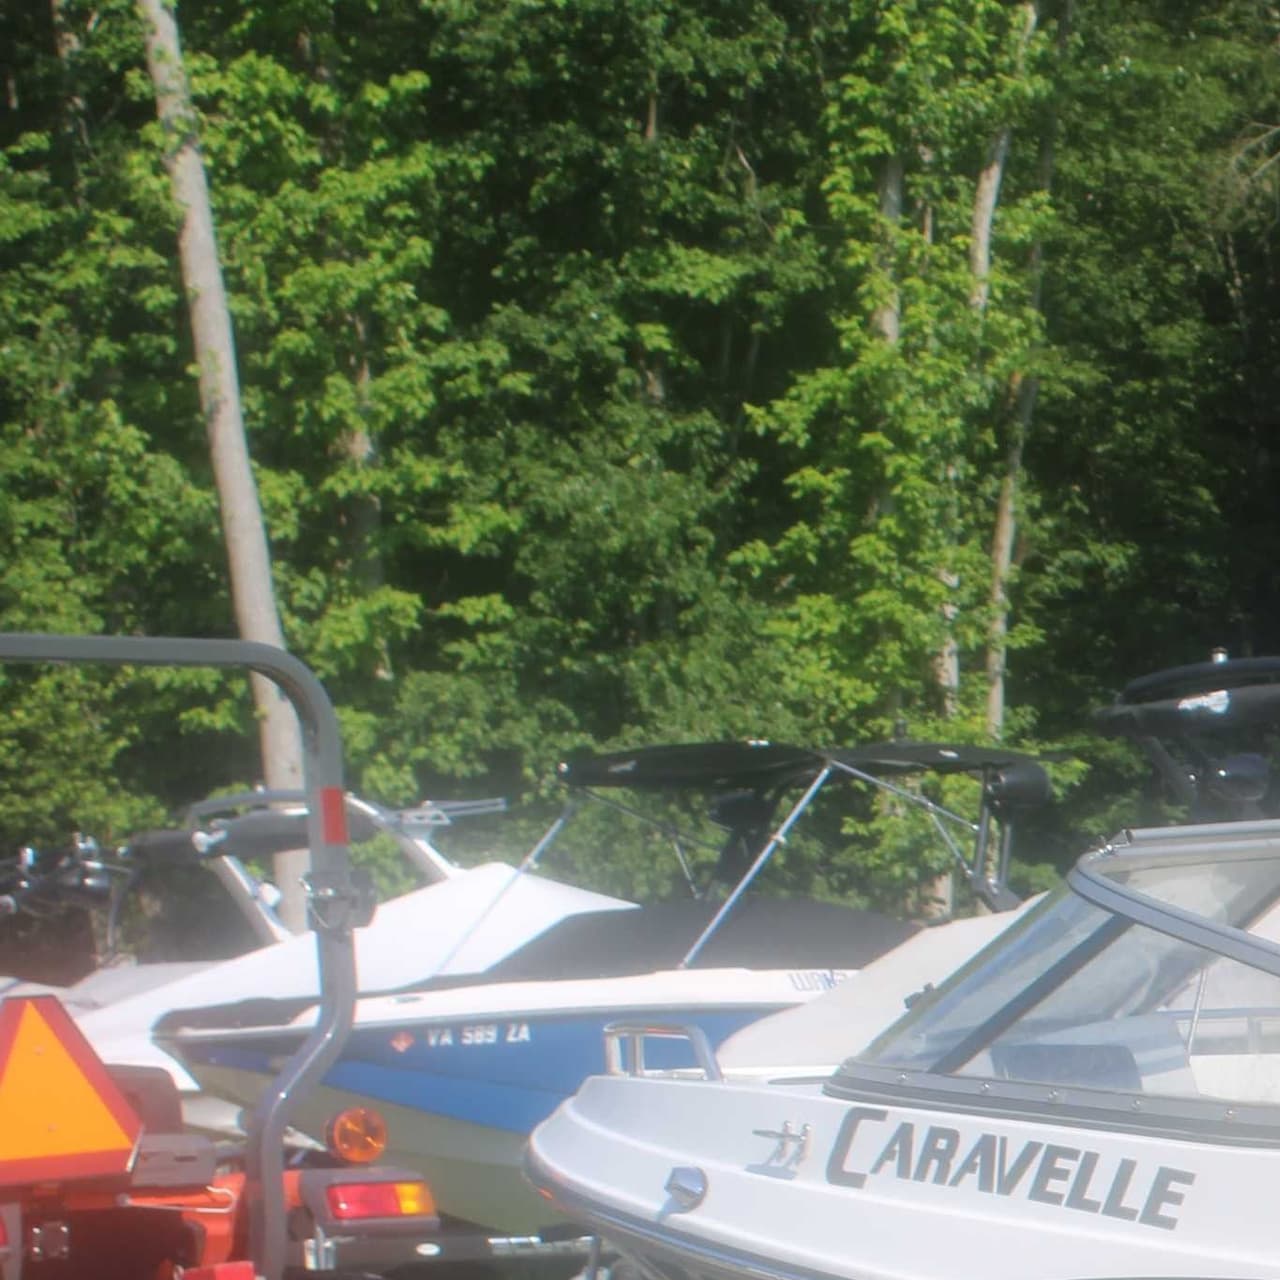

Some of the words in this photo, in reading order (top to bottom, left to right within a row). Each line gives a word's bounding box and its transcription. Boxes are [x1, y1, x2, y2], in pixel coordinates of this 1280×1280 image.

[427, 1028, 453, 1047] VA
[506, 1022, 531, 1043] ZA
[825, 1106, 1197, 1231] CARAVELLE
